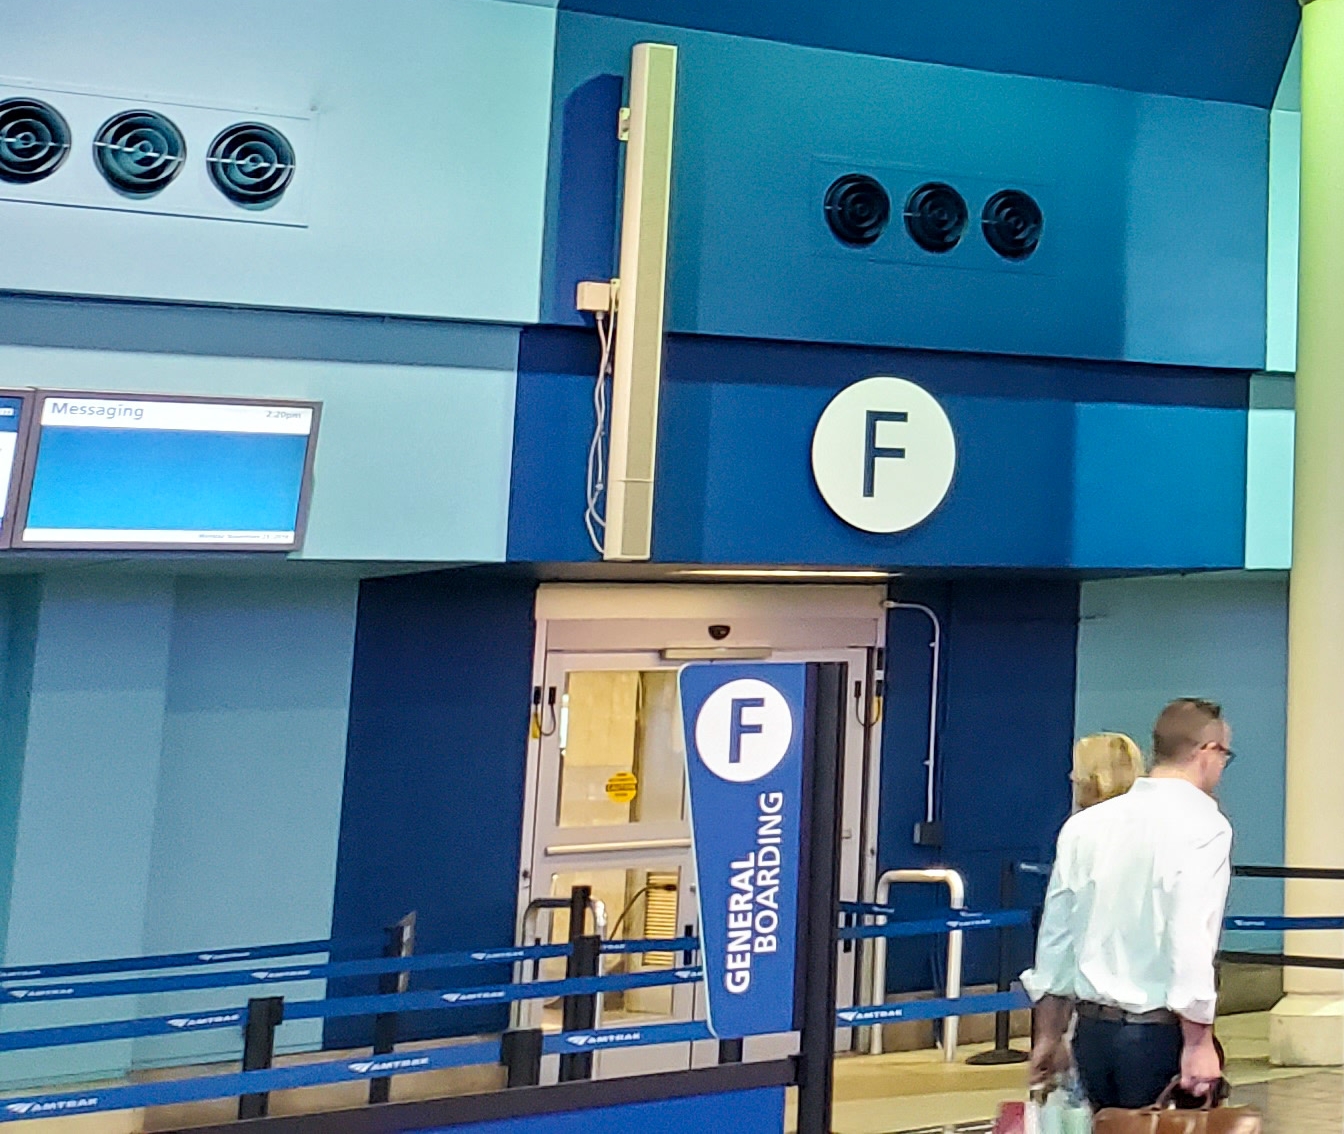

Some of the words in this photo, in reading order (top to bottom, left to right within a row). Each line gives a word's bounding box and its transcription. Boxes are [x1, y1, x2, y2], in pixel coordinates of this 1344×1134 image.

[51, 402, 144, 420] Messaging
[863, 410, 908, 497] F
[728, 697, 765, 764] F
[754, 792, 784, 953] BOARDING
[725, 851, 755, 994] GENERAL
[587, 1032, 640, 1044] AMTRAK
[371, 1057, 429, 1071] AMTRAK
[31, 1097, 98, 1113] AMTRAK
